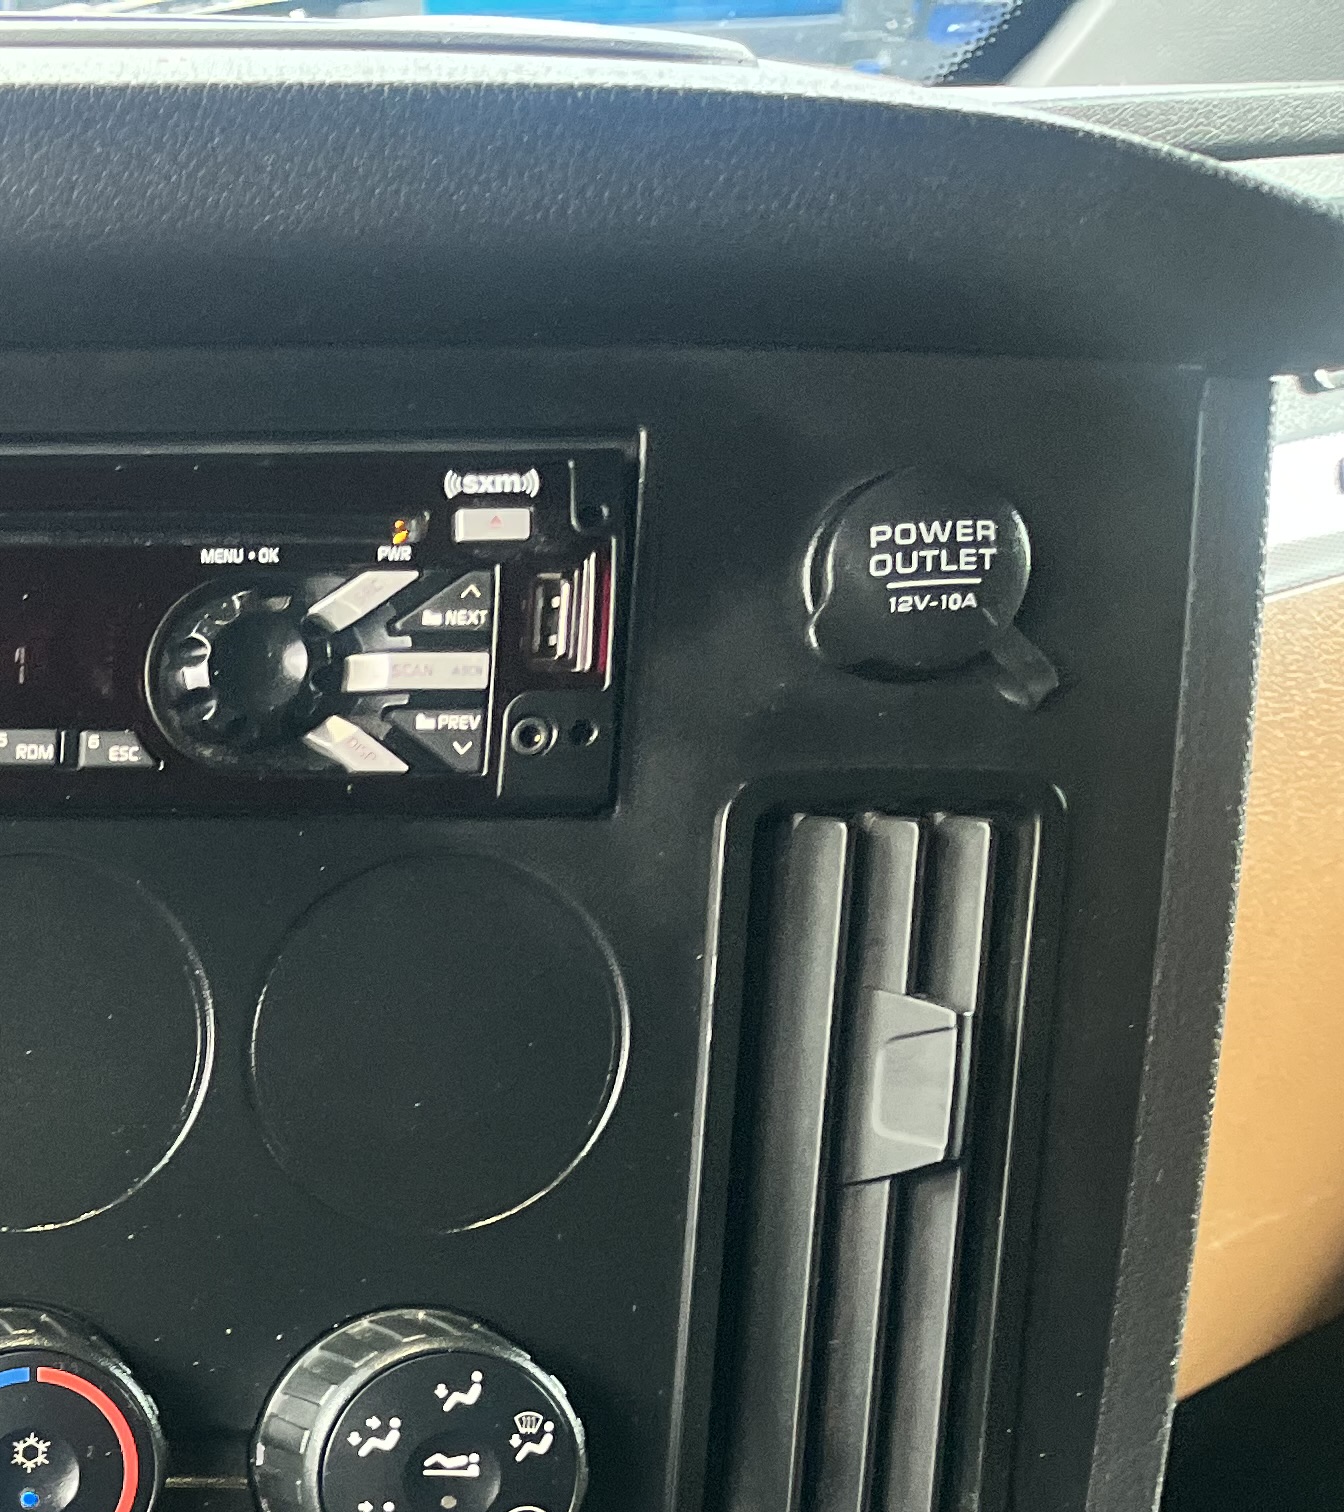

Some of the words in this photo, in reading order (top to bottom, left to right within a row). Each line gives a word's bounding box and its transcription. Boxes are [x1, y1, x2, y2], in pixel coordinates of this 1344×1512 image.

[869, 519, 997, 549] POWER
[200, 547, 244, 564] MENU
[257, 547, 280, 564] OK
[377, 545, 412, 562] PWR
[868, 547, 997, 577] OUTLET
[888, 592, 978, 614] 12V-10A
[444, 609, 488, 627] NEXT
[437, 714, 481, 731] PREV
[15, 743, 55, 761] RDM
[87, 734, 100, 750] 6
[108, 745, 141, 763] ESC
